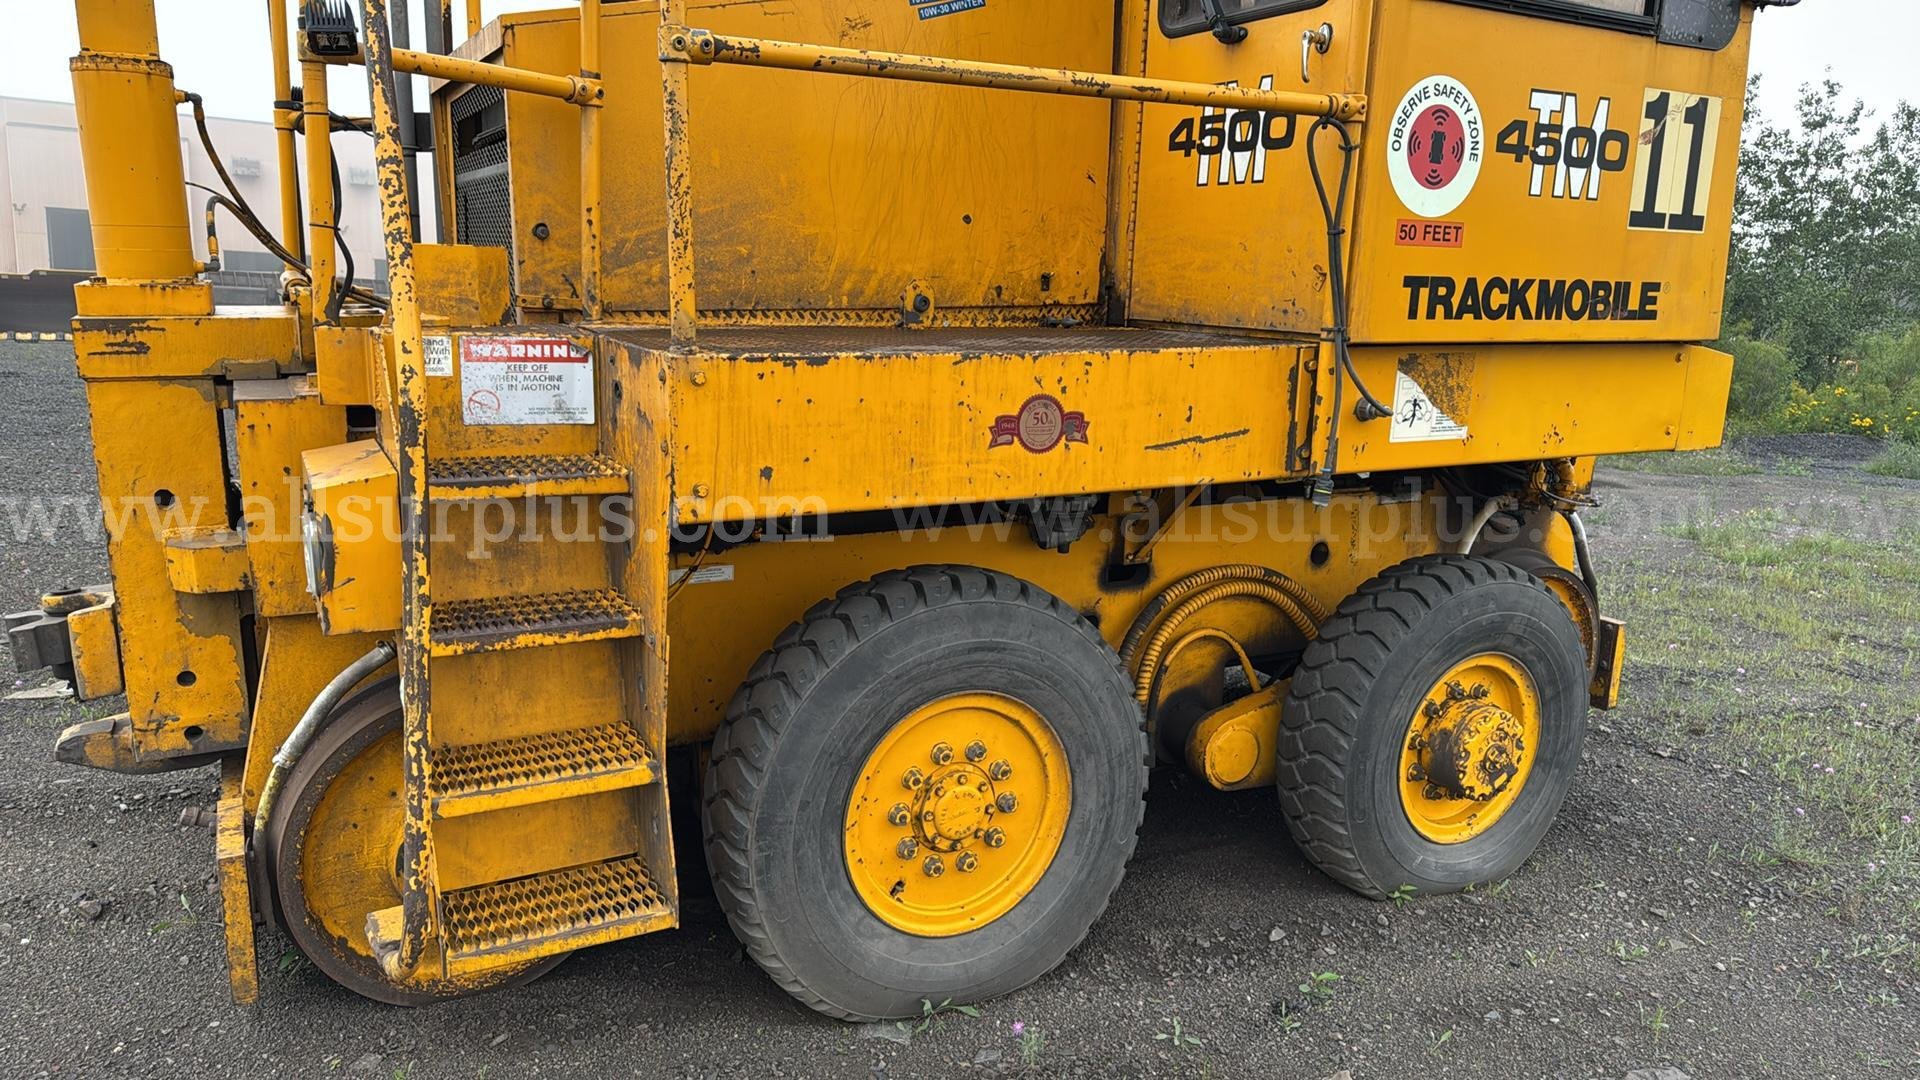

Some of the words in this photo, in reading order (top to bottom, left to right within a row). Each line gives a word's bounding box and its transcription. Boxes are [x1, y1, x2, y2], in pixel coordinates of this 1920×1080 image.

[919, 4, 950, 18] 10W-30
[1168, 108, 1296, 157] 4500
[1391, 85, 1431, 152] OBSERVE
[1433, 82, 1474, 116] SAFETY
[1467, 116, 1480, 163] ZONE
[1495, 119, 1630, 172] 4500
[1528, 88, 1611, 201] TM
[1628, 91, 1710, 231] 11
[1399, 224, 1417, 241] 50
[1422, 224, 1463, 243] FEET
[1402, 275, 1662, 321] TRACKMOBILE
[507, 363, 528, 372] KEEP
[531, 363, 549, 372] OFF
[507, 383, 518, 392] IN
[521, 383, 560, 392] MOTION
[523, 374, 564, 383] MACHINE
